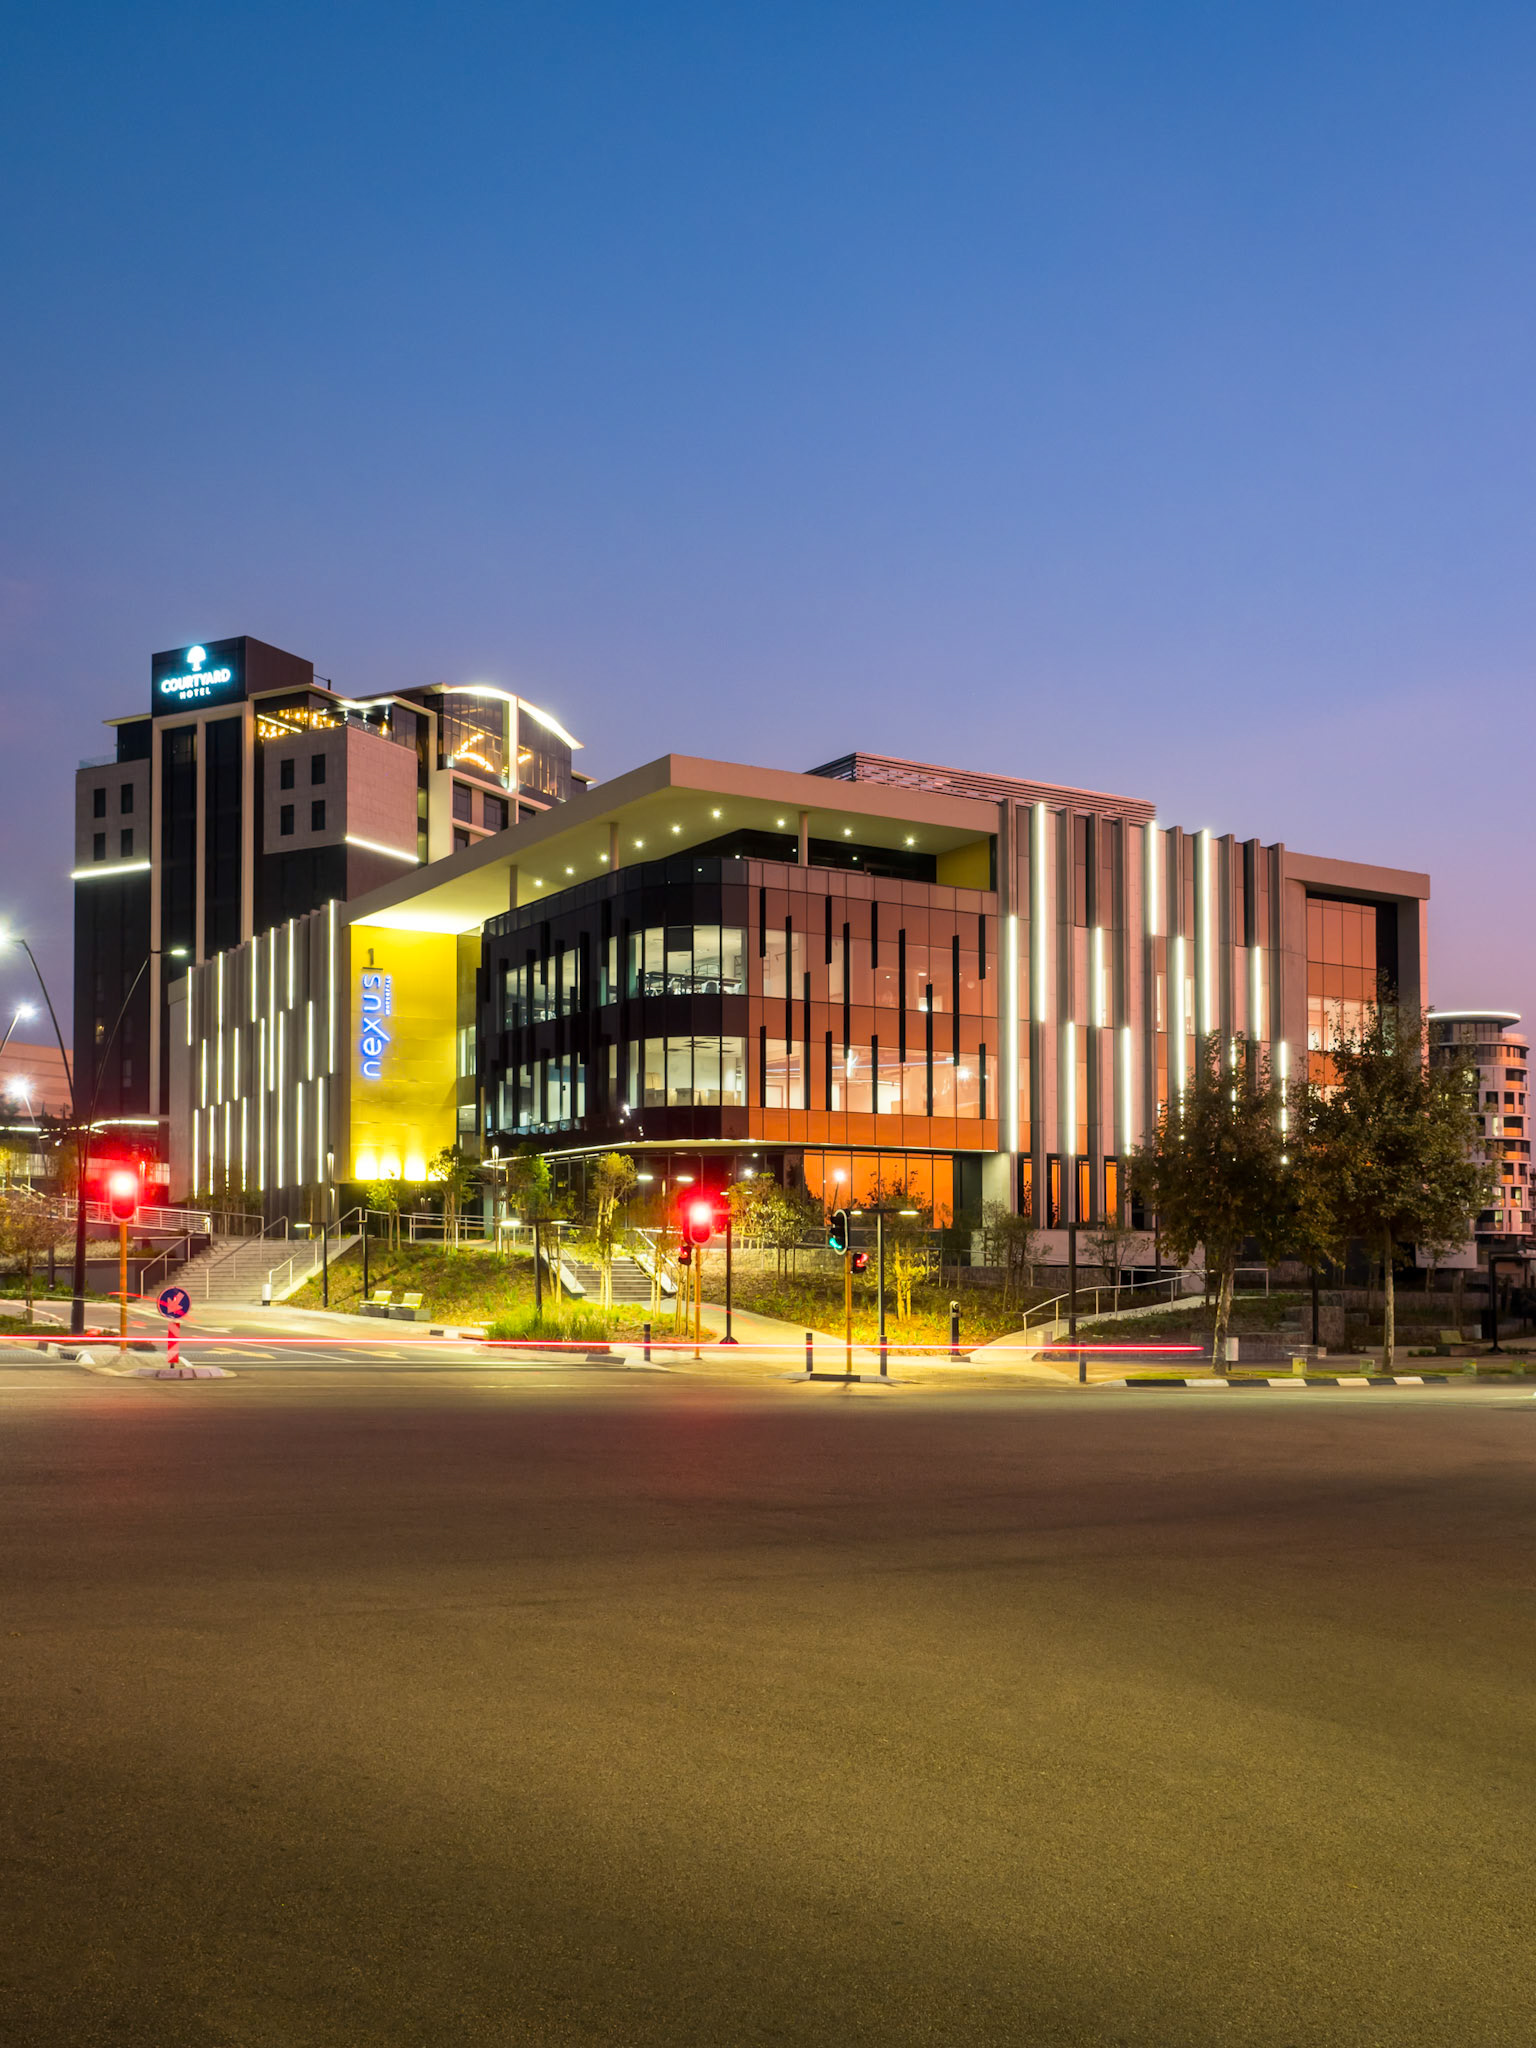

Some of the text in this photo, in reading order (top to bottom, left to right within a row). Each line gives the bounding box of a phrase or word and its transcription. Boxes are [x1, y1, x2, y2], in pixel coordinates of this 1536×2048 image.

[161, 668, 231, 693] COURTYARD
[179, 687, 211, 700] HOTEL
[367, 948, 375, 966] 1
[363, 974, 391, 1077] nexus
